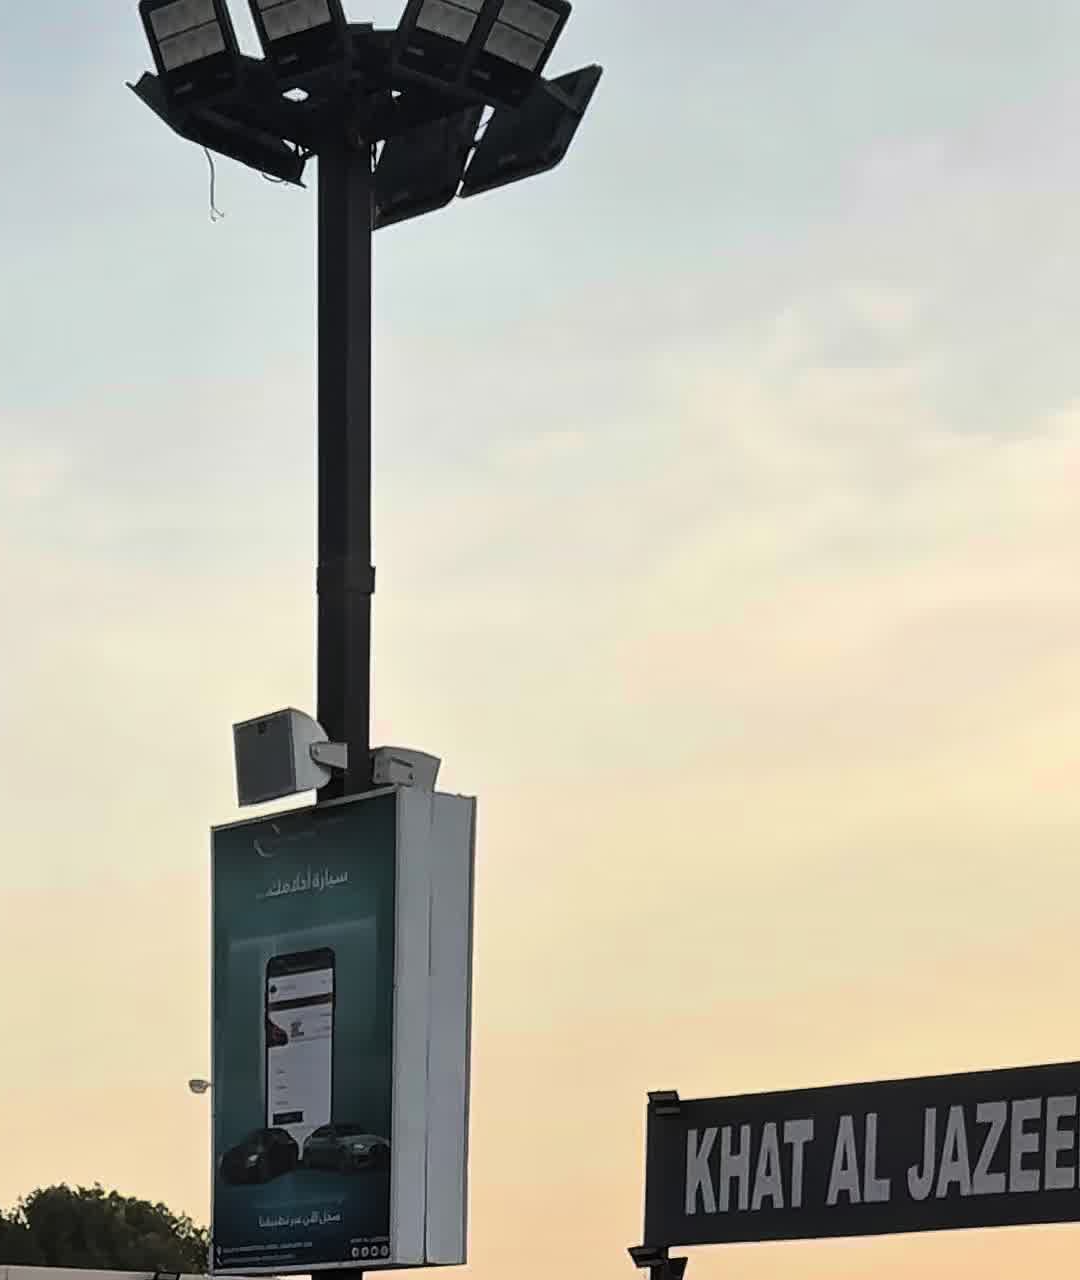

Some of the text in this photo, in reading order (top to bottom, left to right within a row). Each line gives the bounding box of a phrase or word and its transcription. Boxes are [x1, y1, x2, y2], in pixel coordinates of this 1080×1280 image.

[685, 1095, 1080, 1215] KHAT AL JAZEE
